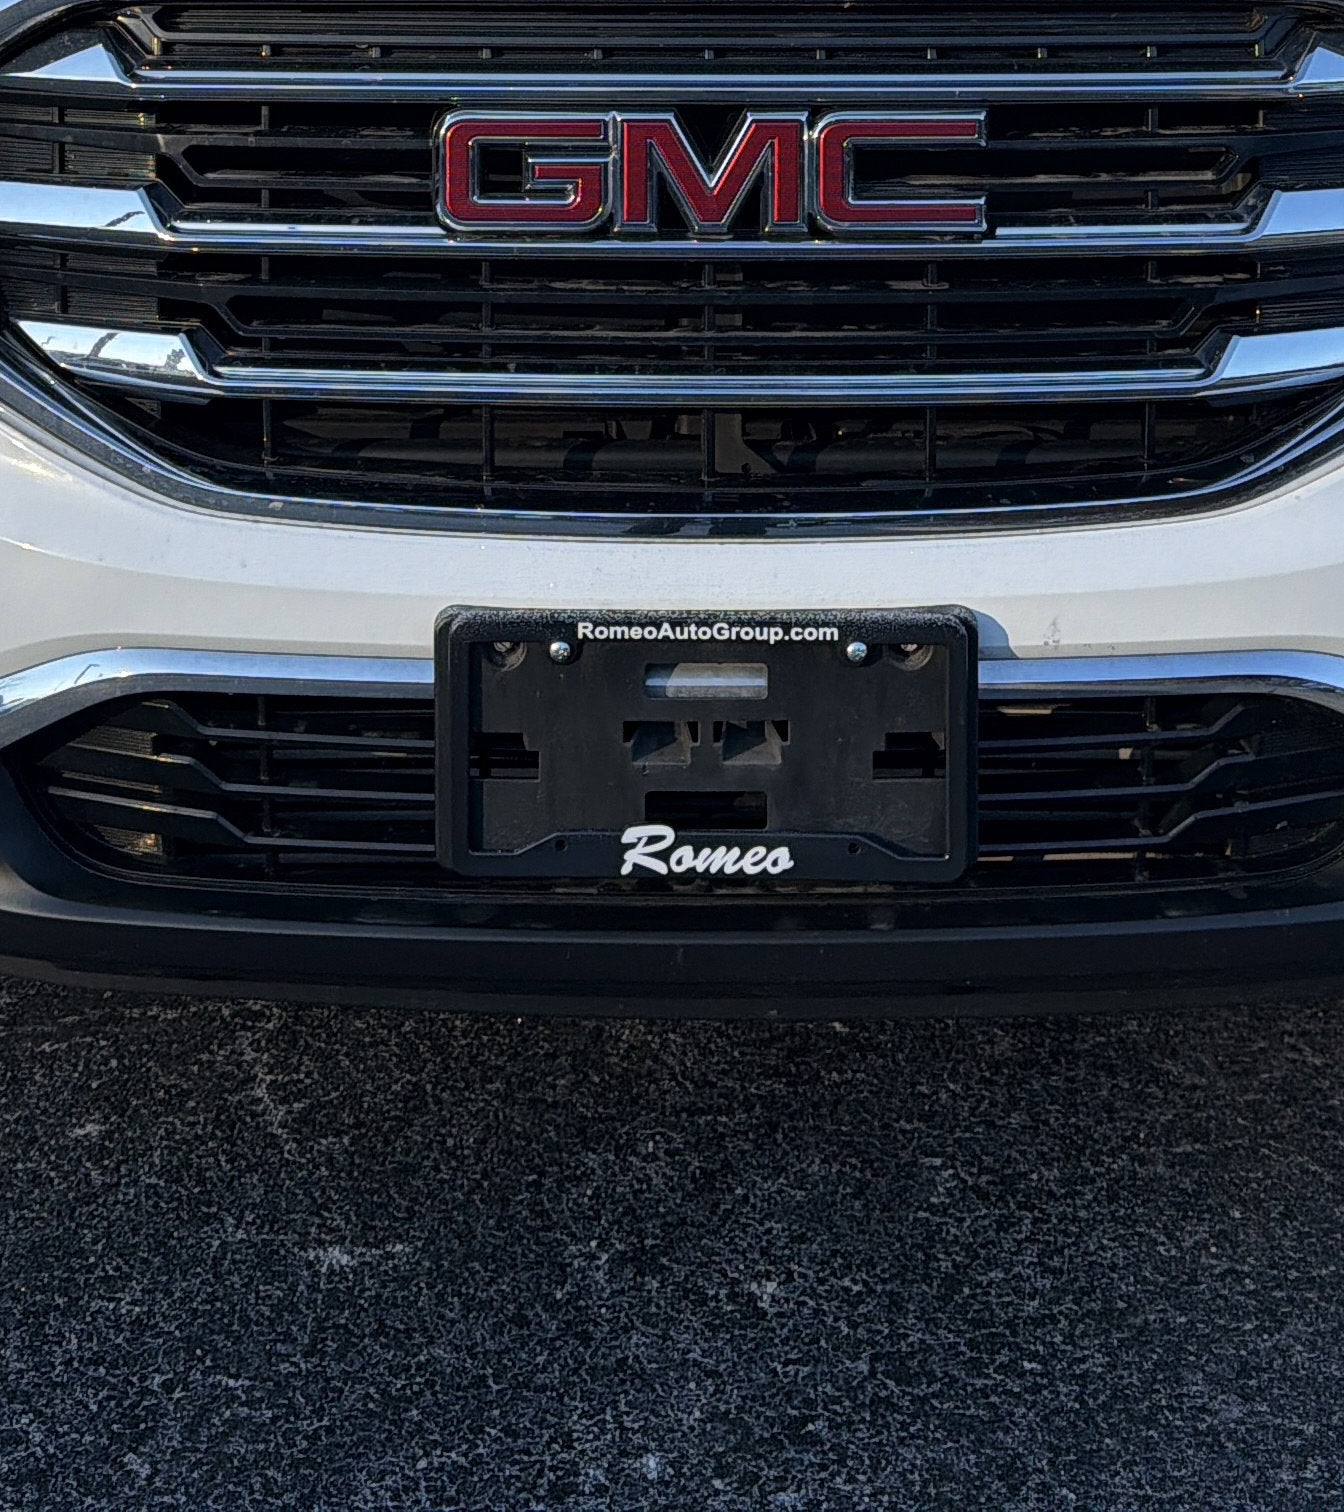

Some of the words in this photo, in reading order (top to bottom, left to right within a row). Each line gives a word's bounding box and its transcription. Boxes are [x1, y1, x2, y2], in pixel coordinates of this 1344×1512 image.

[434, 110, 987, 232] GMC
[577, 622, 839, 644] RomeoAutoGroup.com
[620, 824, 795, 876] Romeo
